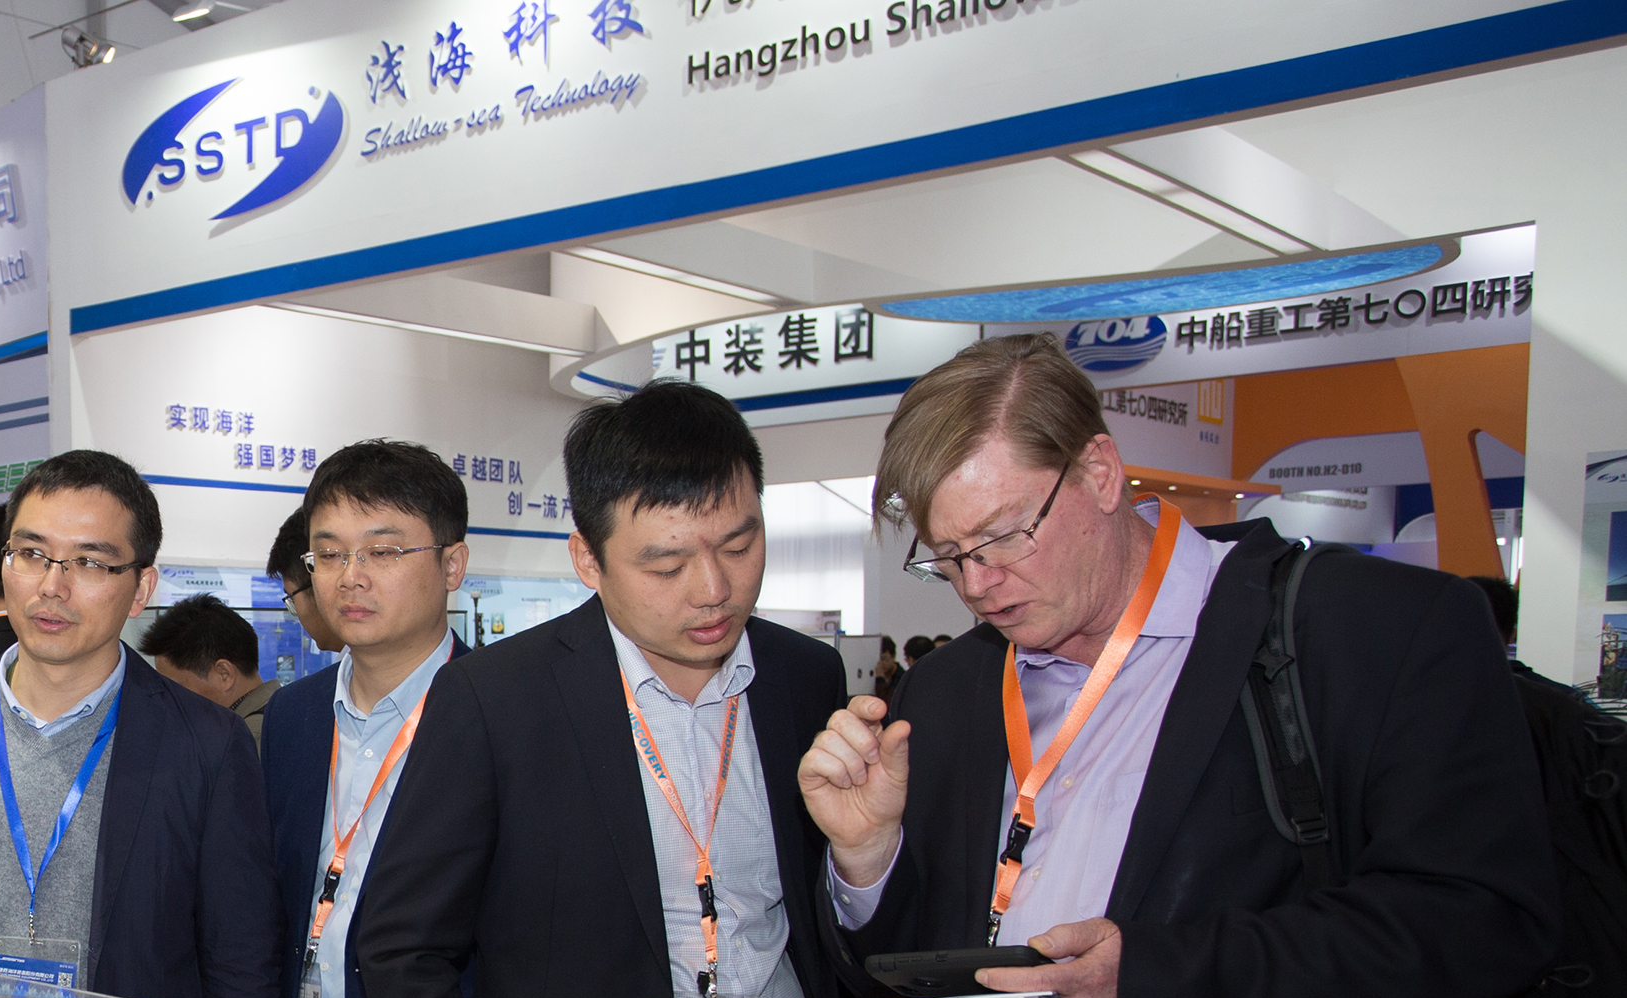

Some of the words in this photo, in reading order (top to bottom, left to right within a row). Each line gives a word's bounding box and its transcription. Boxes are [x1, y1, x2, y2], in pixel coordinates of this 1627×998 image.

[687, 19, 871, 84] Hangzhou
[886, 0, 1024, 35] Shallo
[515, 69, 642, 121] Technology
[157, 106, 310, 187] SSTD
[675, 307, 874, 381] 中装集团
[1076, 317, 1151, 345] 704
[168, 403, 255, 435] 实现海洋
[1100, 391, 1188, 427] 工第七〇四研究所
[237, 443, 317, 470] 强国梦想
[452, 454, 524, 486] 卓越团队
[1269, 467, 1304, 479] BOOTH
[1306, 463, 1362, 477] NO.H2-D10
[721, 705, 737, 780] DISCOVERY
